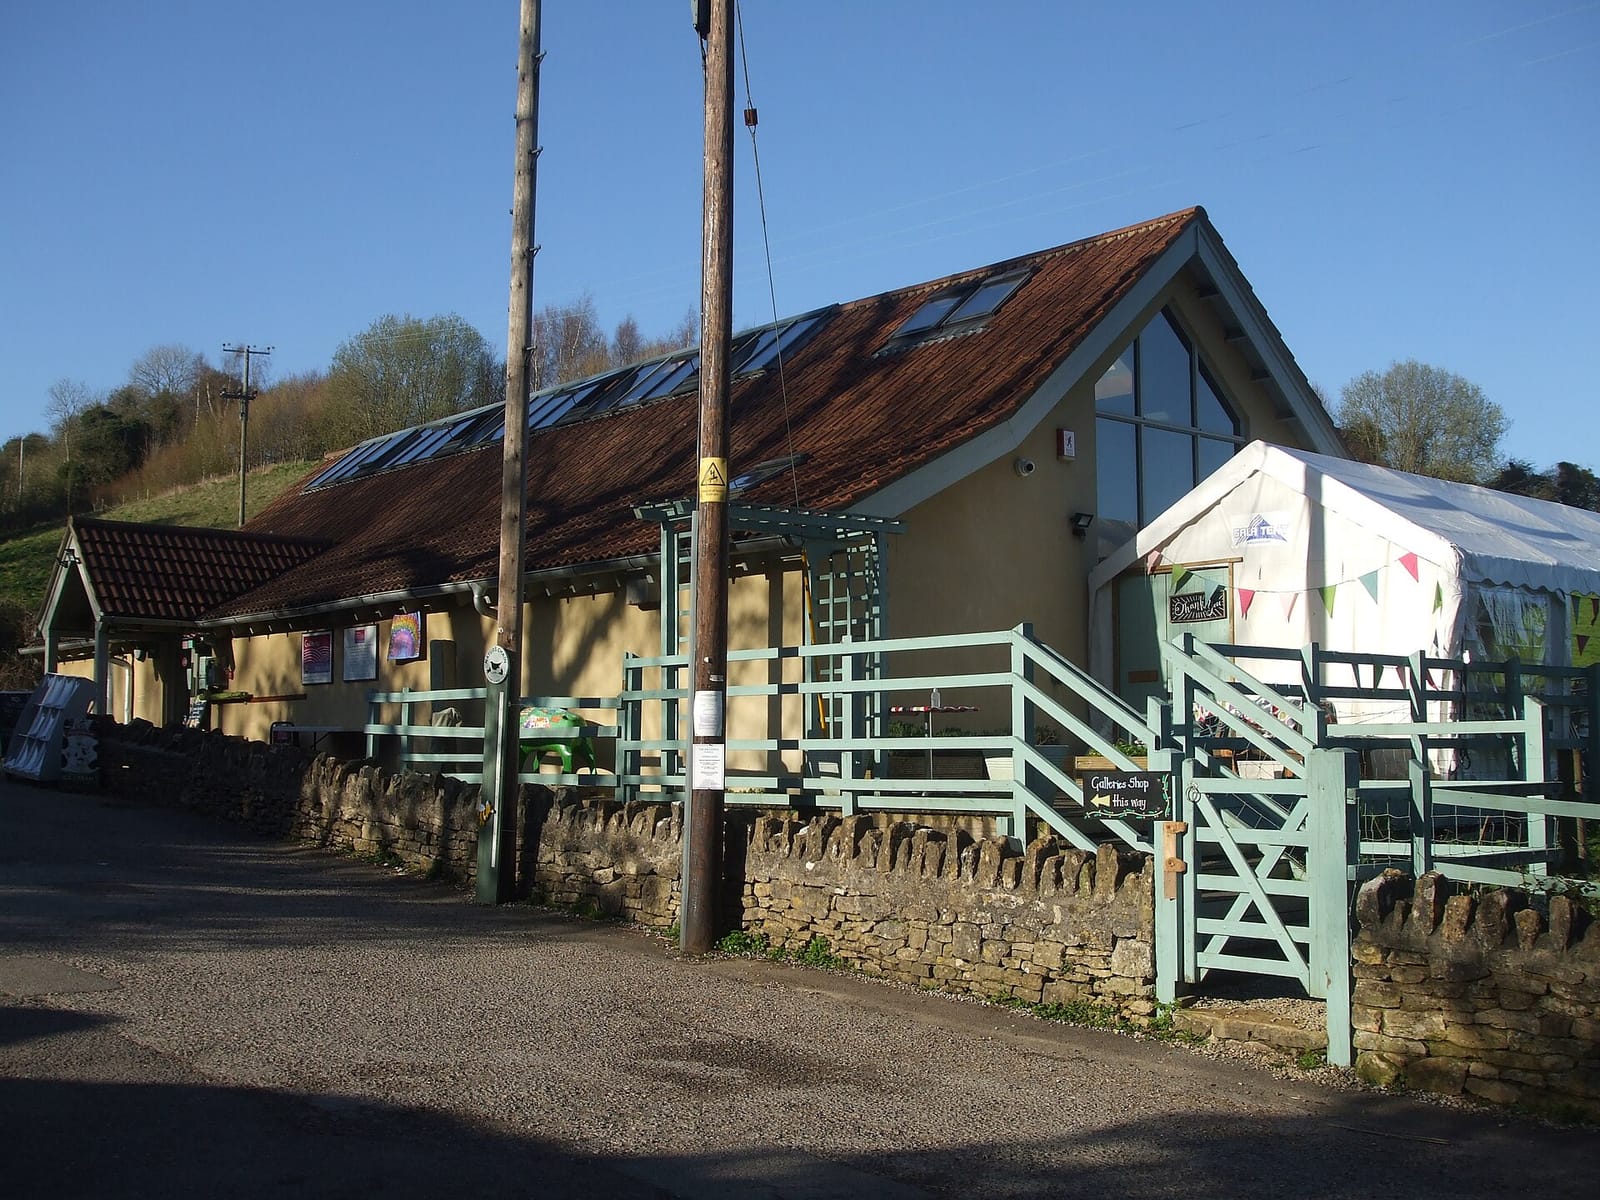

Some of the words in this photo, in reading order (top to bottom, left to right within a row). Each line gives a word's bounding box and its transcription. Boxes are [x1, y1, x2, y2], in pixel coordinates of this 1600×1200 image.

[1091, 776, 1126, 791] Galleries
[1128, 776, 1149, 792] Shop
[1112, 793, 1128, 807] this
[1130, 798, 1146, 810] way
